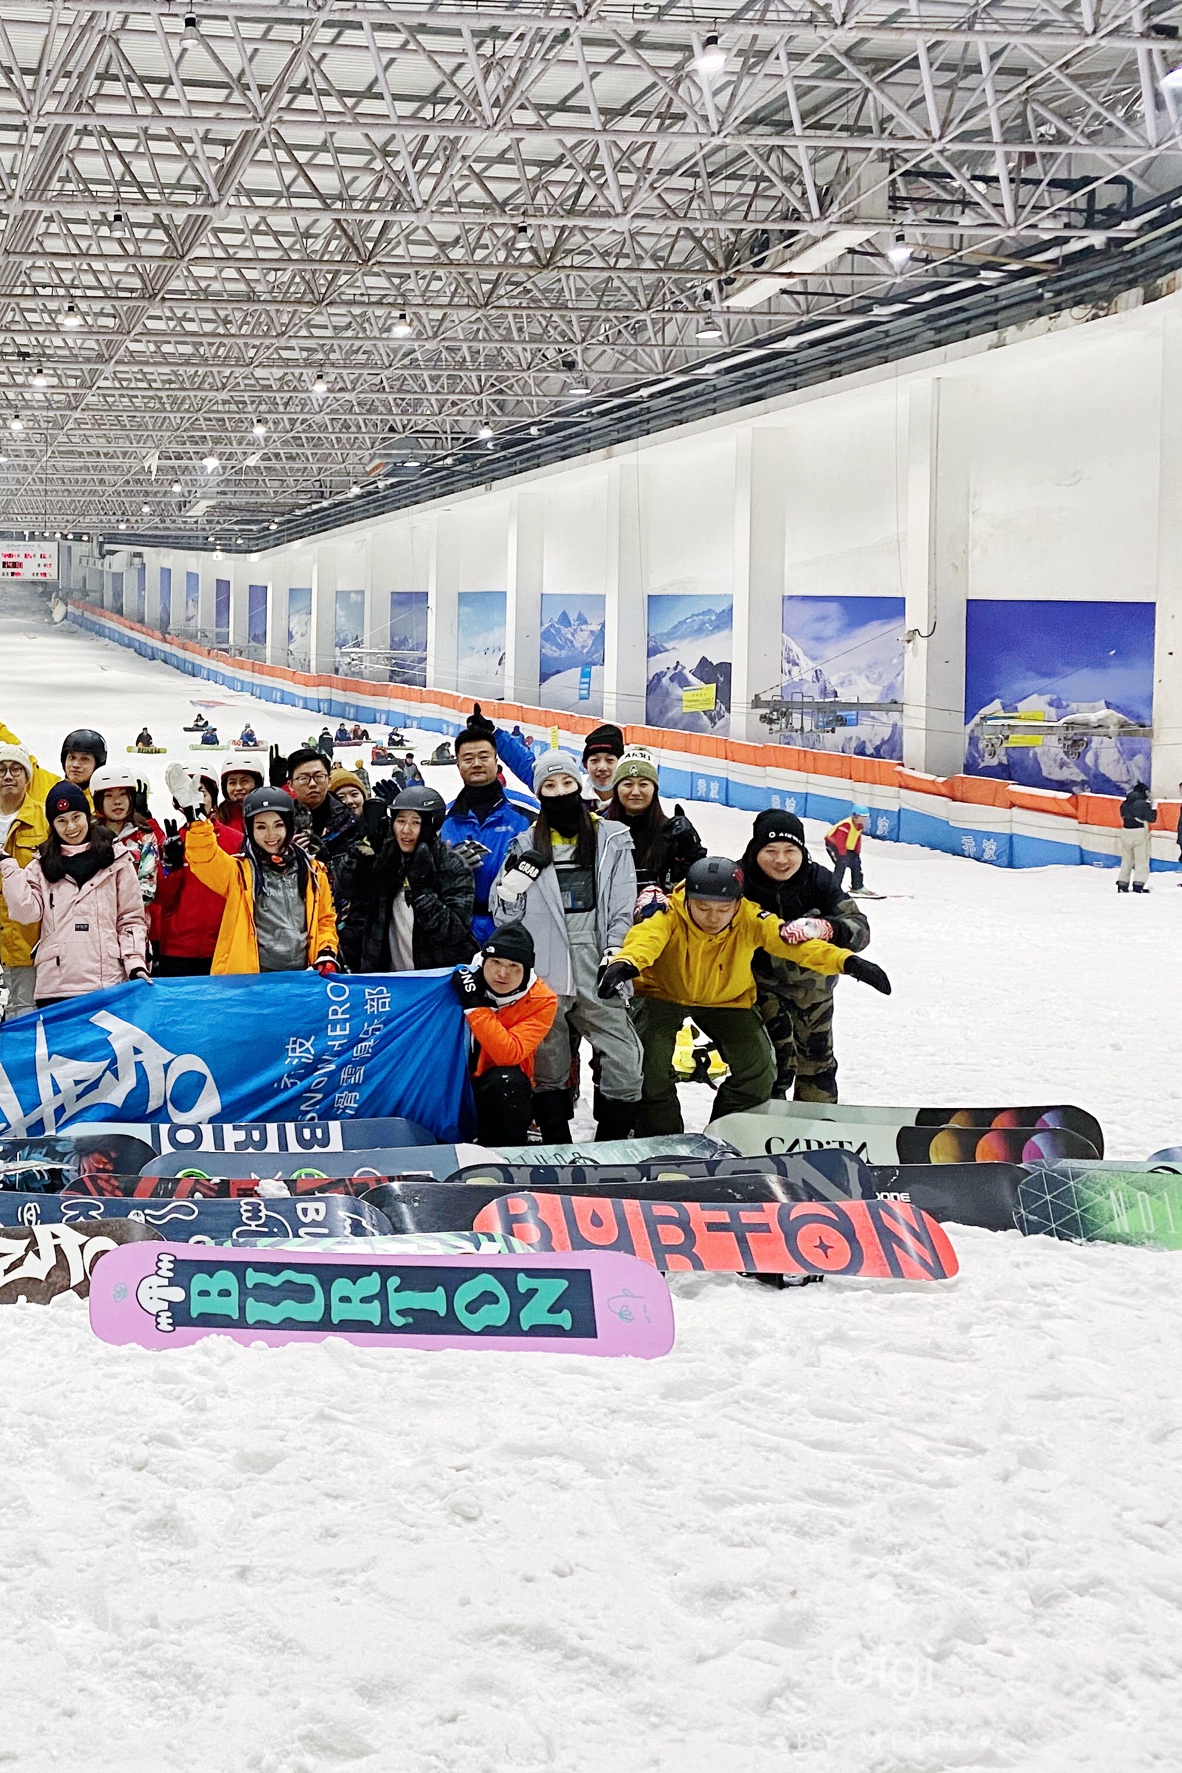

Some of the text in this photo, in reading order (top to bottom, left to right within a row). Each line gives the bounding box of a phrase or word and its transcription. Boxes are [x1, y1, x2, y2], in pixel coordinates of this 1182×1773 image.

[518, 860, 540, 878] GRAB
[333, 985, 392, 1116] 滑雪俱乐部
[500, 1192, 950, 1281] BURTON
[189, 1267, 574, 1334] BURTON
